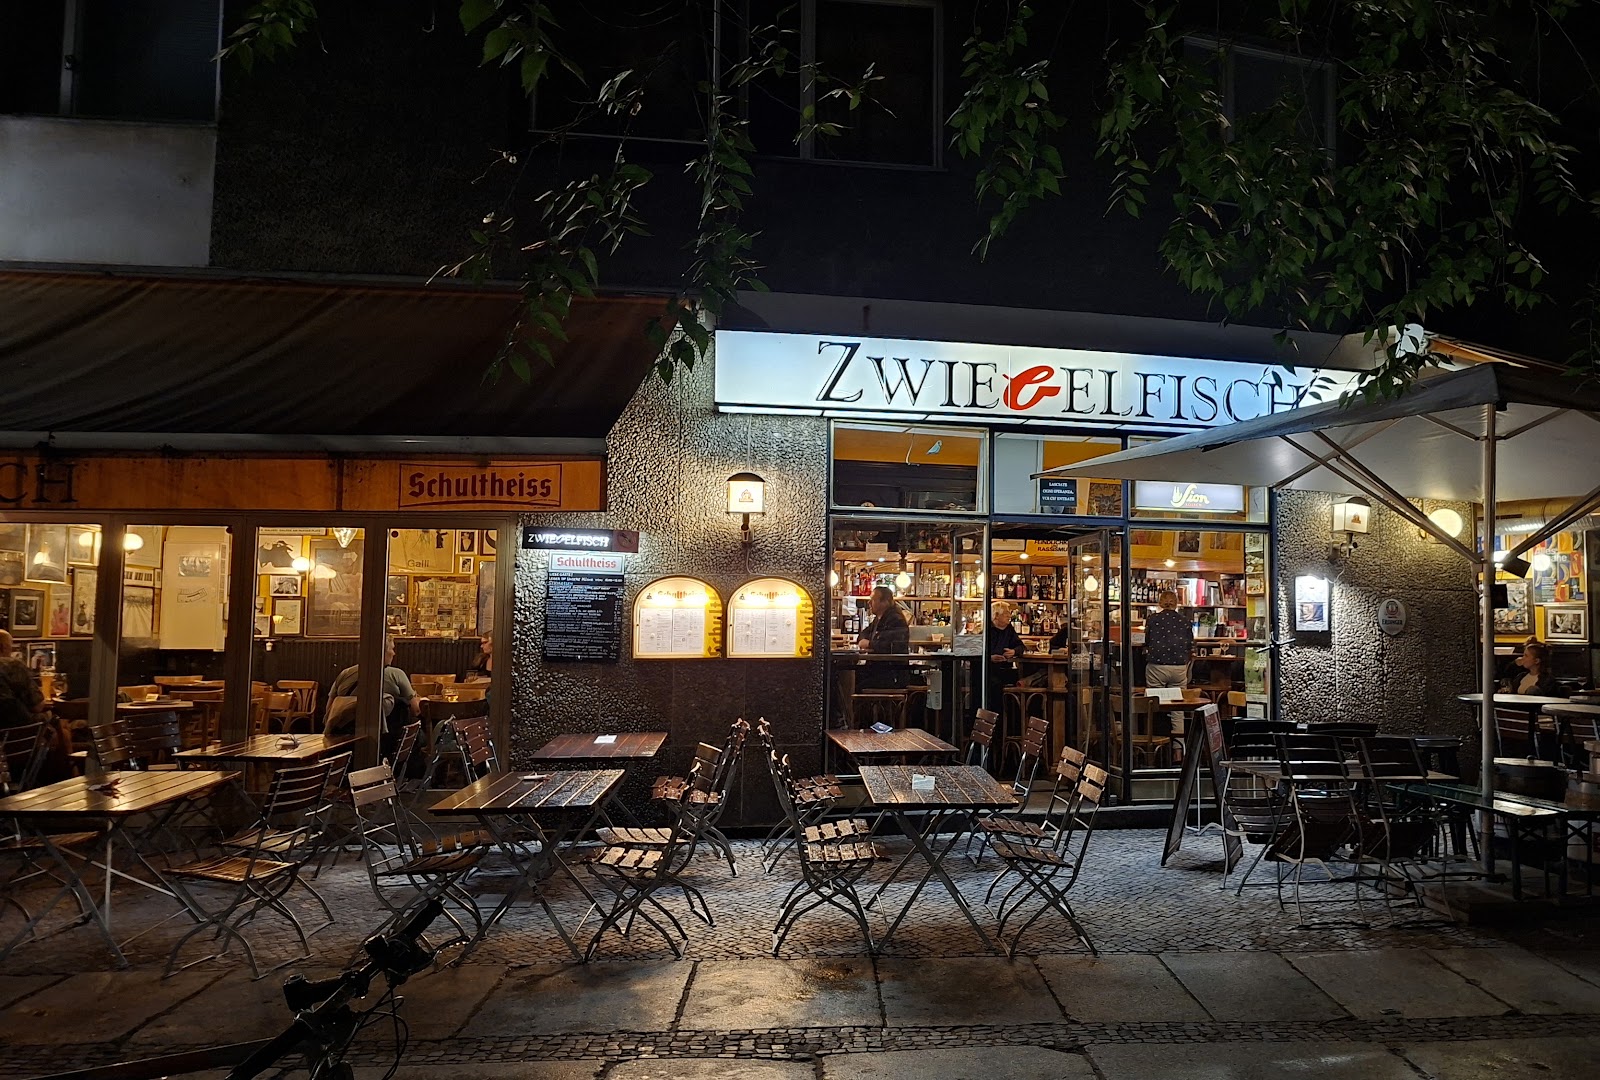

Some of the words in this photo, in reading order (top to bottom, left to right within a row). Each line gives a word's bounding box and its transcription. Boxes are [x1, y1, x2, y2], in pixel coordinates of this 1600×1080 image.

[408, 472, 553, 499] Schultheiss
[407, 559, 430, 568] Galli
[557, 556, 616, 568] Schultheiss
